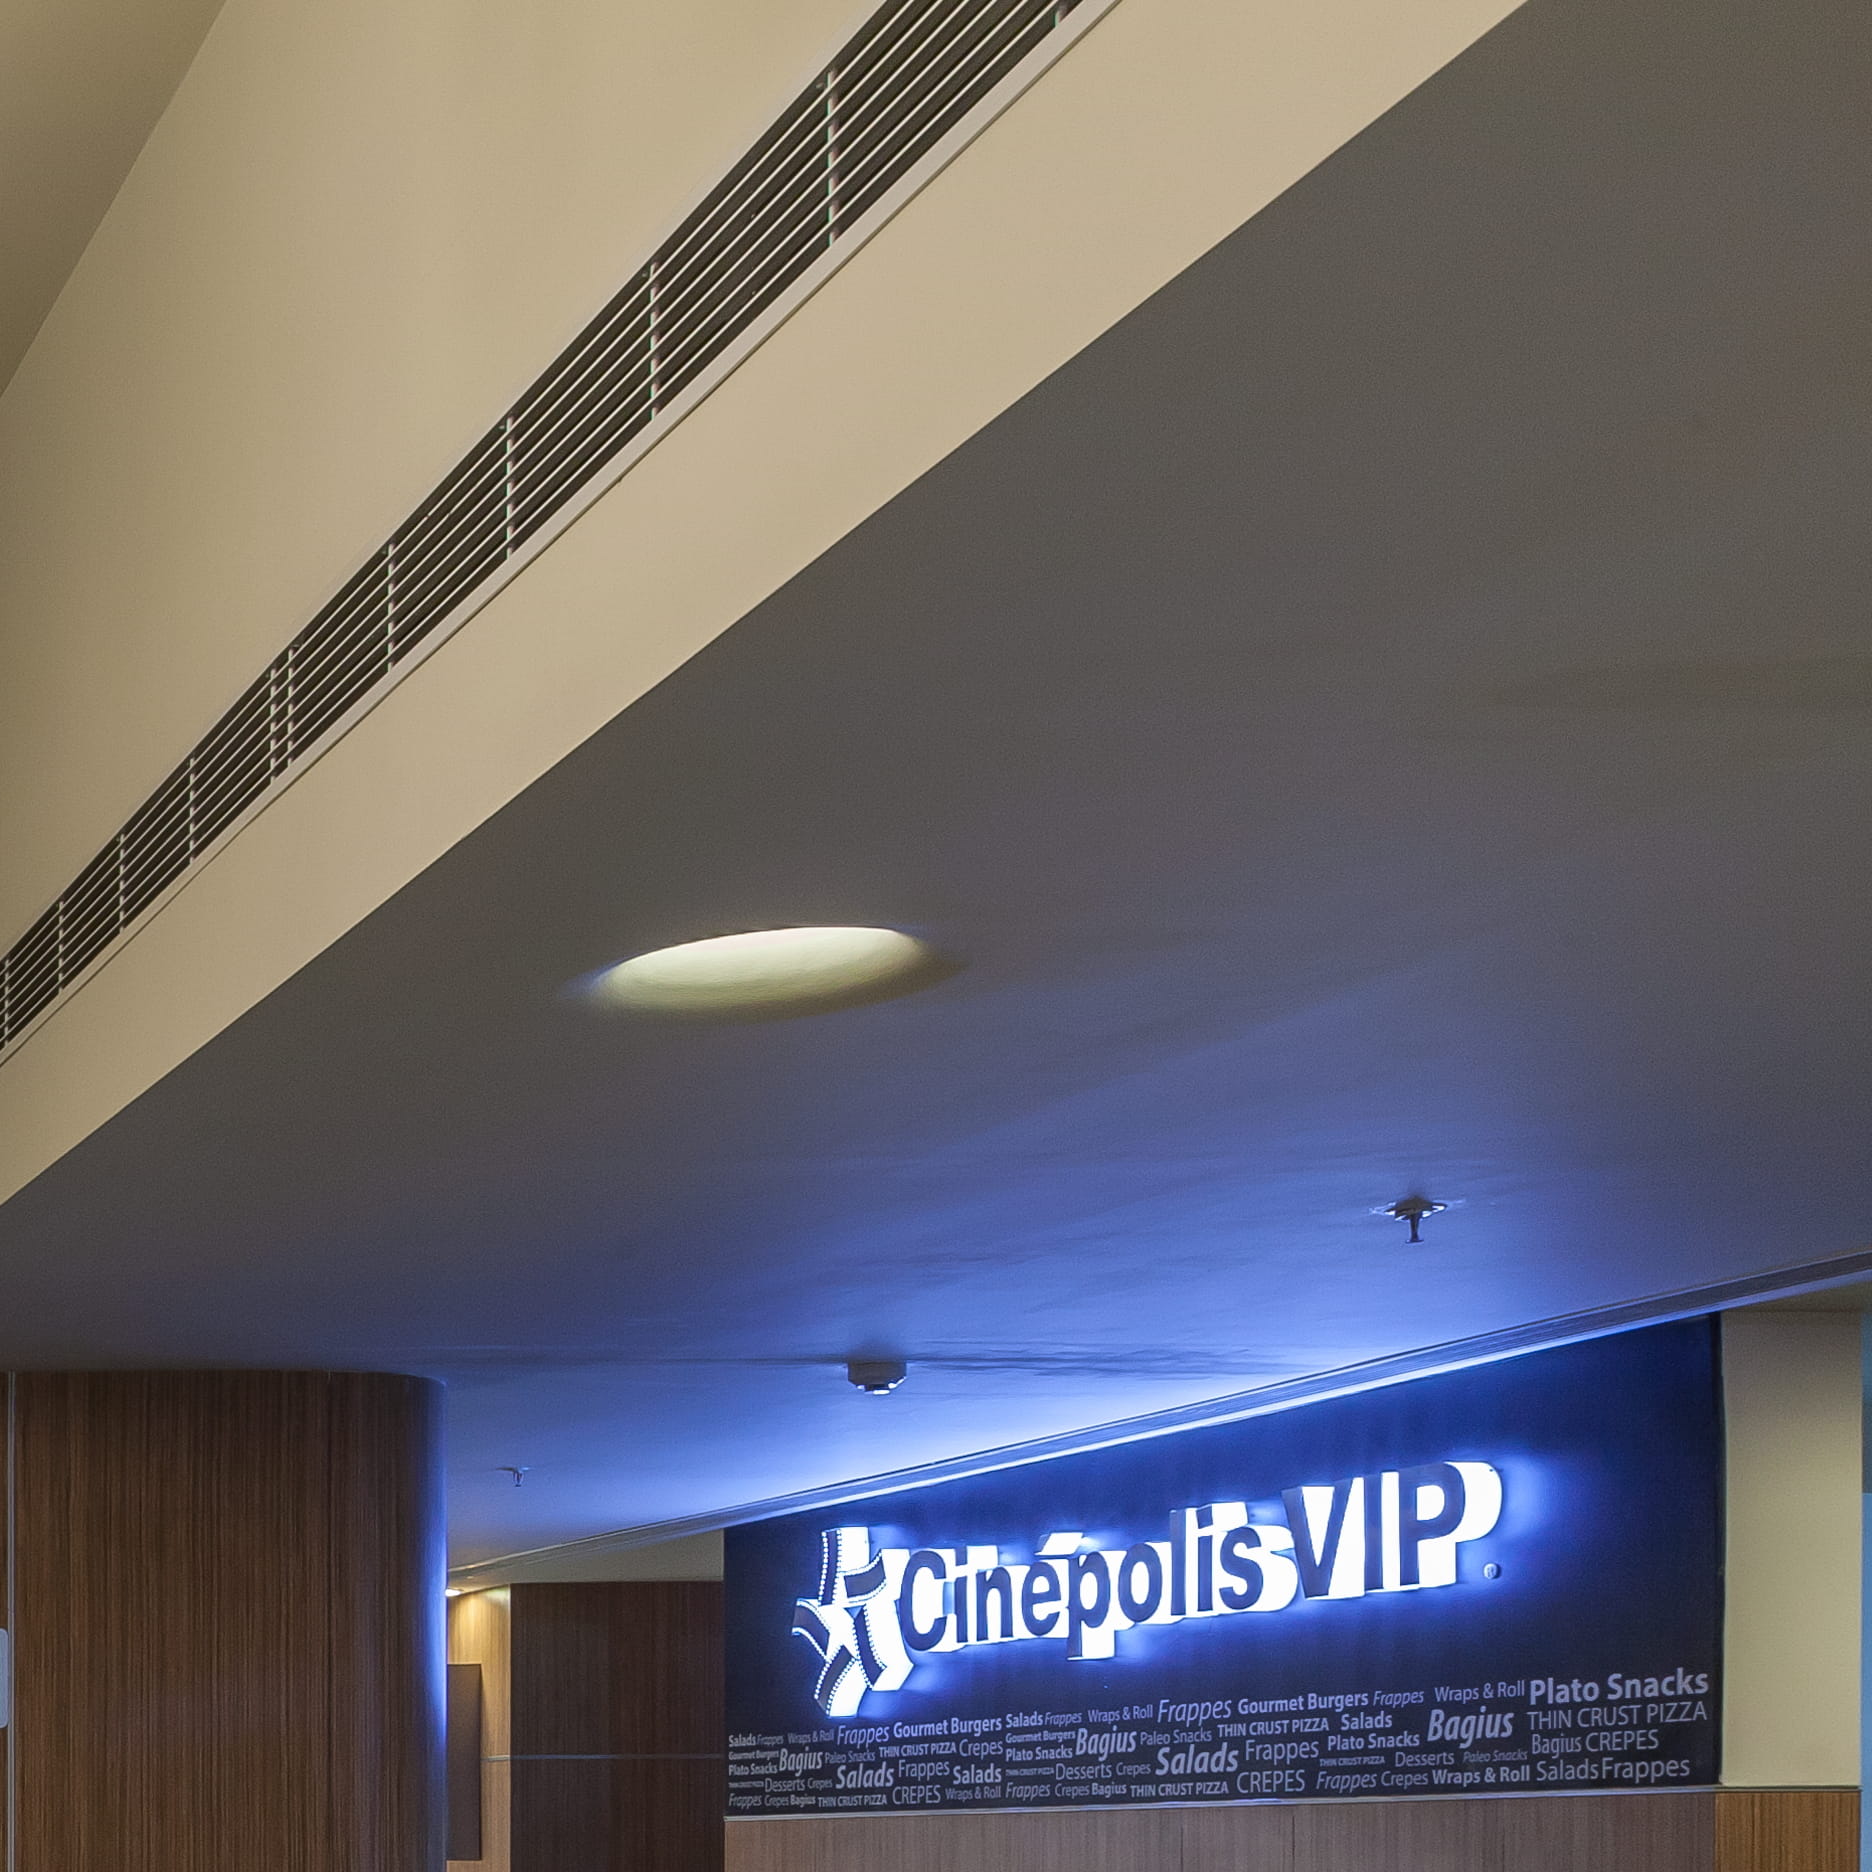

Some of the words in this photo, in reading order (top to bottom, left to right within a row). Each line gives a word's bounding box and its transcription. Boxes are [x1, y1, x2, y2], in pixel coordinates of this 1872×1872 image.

[898, 1502, 1290, 1661] Cinépolis
[1282, 1462, 1499, 1600] VIP
[1434, 1686, 1479, 1704] Wraps
[1482, 1682, 1494, 1699] &
[1497, 1680, 1525, 1697] Roll
[1530, 1677, 1599, 1705] Plato
[1607, 1667, 1709, 1700] Snacks
[1238, 1695, 1304, 1715] Gourmet
[1307, 1691, 1369, 1712] Burgers
[1372, 1689, 1425, 1708] Frappes
[1006, 1711, 1043, 1728] Salads
[1044, 1712, 1083, 1727] Frappes
[1087, 1709, 1120, 1725] Wraps
[1122, 1706, 1130, 1720] &
[1133, 1704, 1153, 1719] Roll
[1157, 1699, 1232, 1728] Frappes
[1340, 1711, 1393, 1731] Salads
[1527, 1710, 1572, 1731] THIN
[1577, 1705, 1641, 1728] CRUST
[1647, 1701, 1708, 1723] PIZZA
[836, 1725, 890, 1749] Frappes
[893, 1719, 948, 1738] Gourmet
[951, 1717, 1002, 1737] Burgers
[1043, 1730, 1076, 1743] Burgers
[1140, 1731, 1171, 1746] Paleo
[1173, 1727, 1213, 1744] Snacks
[1217, 1723, 1246, 1738] THIN
[1249, 1720, 1289, 1736] CRUST
[1292, 1717, 1329, 1733] PIZZA
[1427, 1705, 1514, 1749] Bagius
[728, 1733, 756, 1748] Salads
[879, 1746, 900, 1758] THIN
[901, 1743, 929, 1757] CRUST
[931, 1742, 956, 1755] PIZZA
[959, 1739, 1003, 1760] Crepes
[1075, 1724, 1137, 1762] Bagius
[1328, 1735, 1364, 1751] Plato
[1368, 1731, 1420, 1749] Snacks
[1532, 1732, 1581, 1759] Bagius
[1585, 1729, 1659, 1752] CREPES
[778, 1746, 823, 1777] Bagius
[1006, 1748, 1033, 1762] Plato
[1035, 1744, 1073, 1760] Snacks
[1156, 1743, 1239, 1776] Salads
[1246, 1739, 1319, 1766] Frappes
[1395, 1752, 1454, 1767] Desserts
[1493, 1749, 1528, 1762] Snacks
[728, 1765, 749, 1776] Plato
[750, 1762, 778, 1775] Snacks
[836, 1761, 894, 1789] Salads
[898, 1760, 950, 1781] Frappes
[953, 1762, 1002, 1785] Salads
[1056, 1763, 1112, 1780] Desserts
[1116, 1762, 1151, 1777] Crepes
[1432, 1768, 1481, 1787] Wraps
[1484, 1767, 1496, 1783] &
[1500, 1765, 1530, 1782] Roll
[1536, 1760, 1599, 1782] Salads
[1602, 1757, 1690, 1784] Frappes
[764, 1778, 805, 1793] Desserts
[1055, 1783, 1089, 1799] Crepes
[1091, 1782, 1127, 1798] Bagius
[1130, 1785, 1156, 1798] THIN
[1158, 1782, 1193, 1797] CRUST
[1195, 1781, 1229, 1795] PIZZA
[1237, 1769, 1305, 1794] CREPES
[1316, 1771, 1377, 1794] Frappes
[1381, 1771, 1429, 1790] Crepes
[818, 1797, 836, 1808] THIN
[837, 1795, 862, 1807] CRUST
[864, 1793, 887, 1806] PIZZA
[892, 1784, 941, 1805] CREPES
[945, 1787, 973, 1802] Wraps
[974, 1786, 982, 1799] &
[983, 1785, 1001, 1799] Roll
[1005, 1782, 1051, 1801] Frappes
